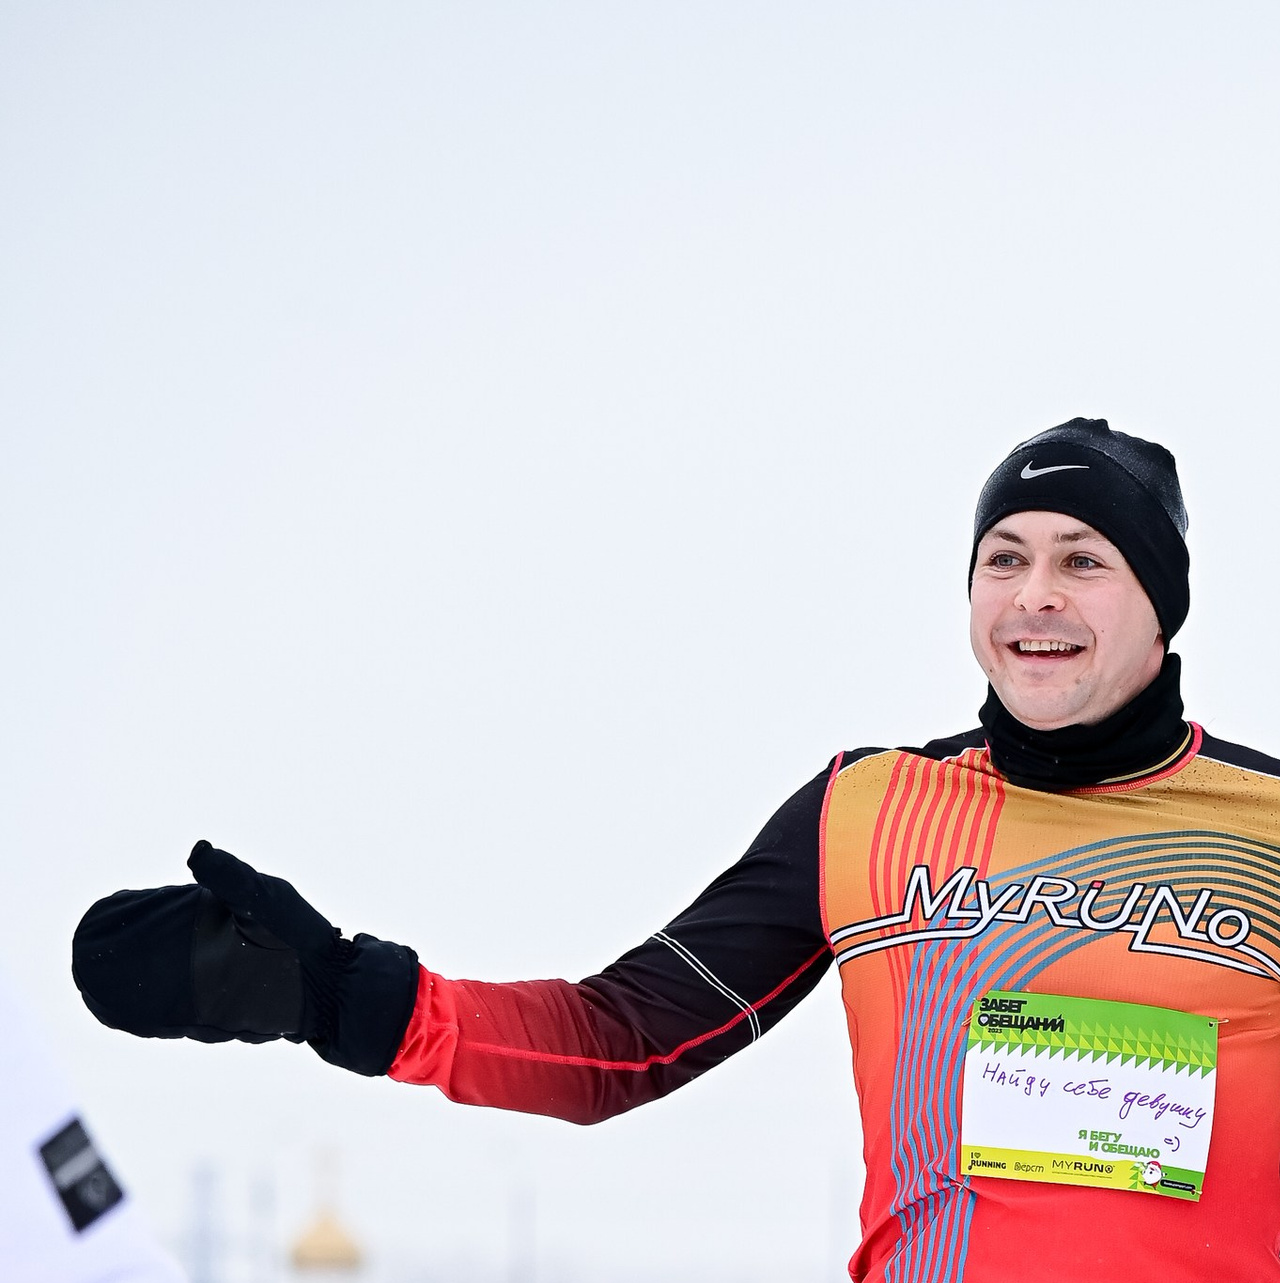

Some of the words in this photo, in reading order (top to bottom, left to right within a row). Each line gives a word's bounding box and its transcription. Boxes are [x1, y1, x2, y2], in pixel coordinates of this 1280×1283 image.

[980, 998, 1028, 1014] ЗАБЕГ
[978, 1013, 1065, 1034] ОБЕЩАНИЙ
[1063, 1079, 1112, 1099] себе
[1118, 1091, 1207, 1129] девушку
[1078, 1129, 1087, 1140] Я
[1090, 1130, 1122, 1143] БЕГУ
[1088, 1141, 1099, 1152] И
[1101, 1142, 1160, 1159] ОБЕЩАЮ
[968, 1160, 1007, 1171] RUNNING
